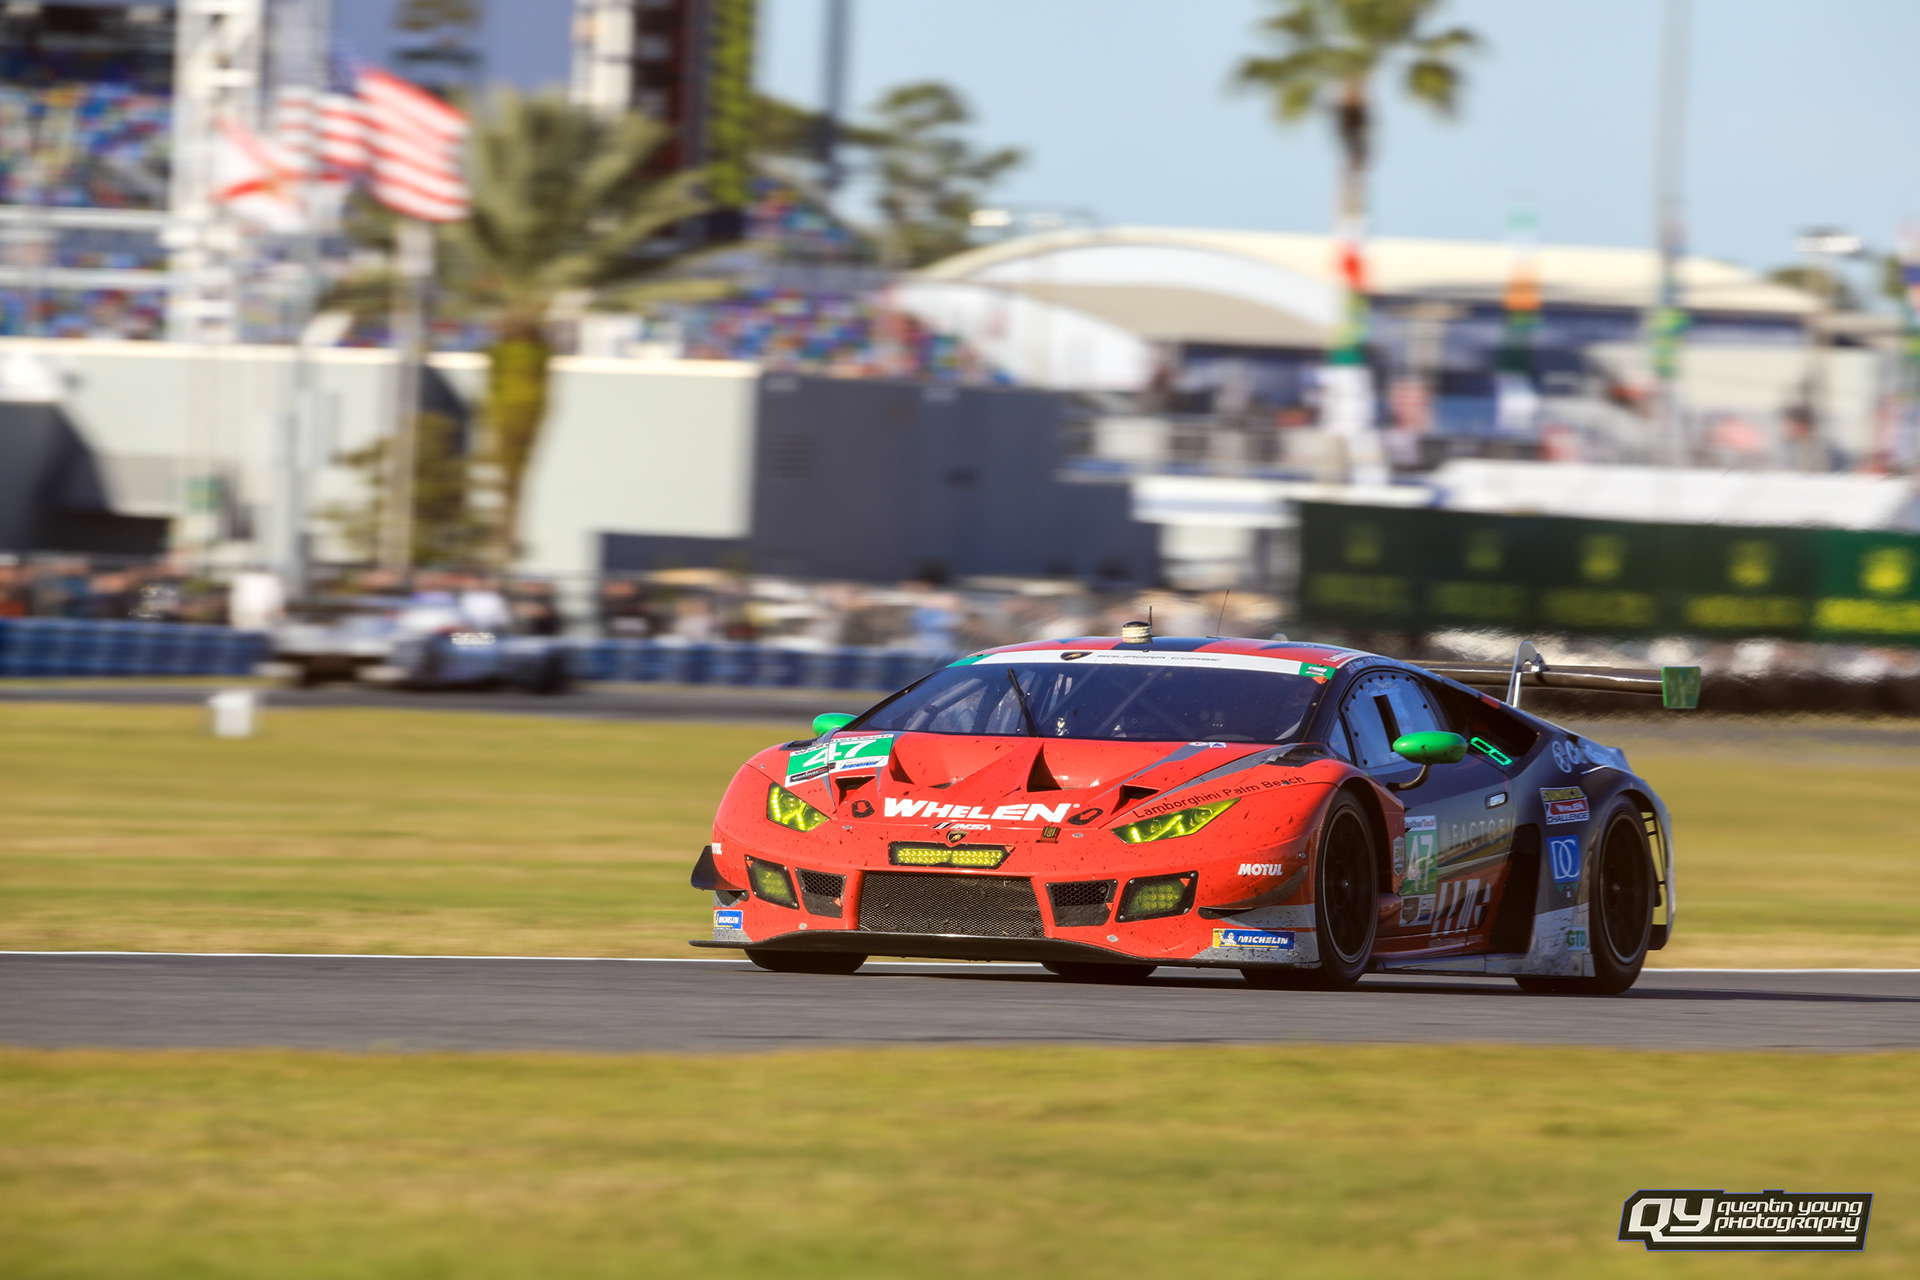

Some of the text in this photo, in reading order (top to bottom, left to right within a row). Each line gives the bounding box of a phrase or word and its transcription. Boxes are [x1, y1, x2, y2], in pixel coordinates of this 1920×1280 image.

[803, 739, 877, 768] 47
[1132, 774, 1306, 819] Lamborghini Palm Beach
[884, 797, 1072, 823] WHELEN
[1547, 813, 1589, 823] CHALLENGE
[950, 822, 991, 831] IMSA
[1405, 819, 1435, 829] eatherTech
[1407, 834, 1434, 892] 47
[1551, 839, 1580, 880] DC
[1237, 863, 1283, 876] MOTUL
[1238, 935, 1289, 945] MICHELIN
[1567, 930, 1586, 947] GTD
